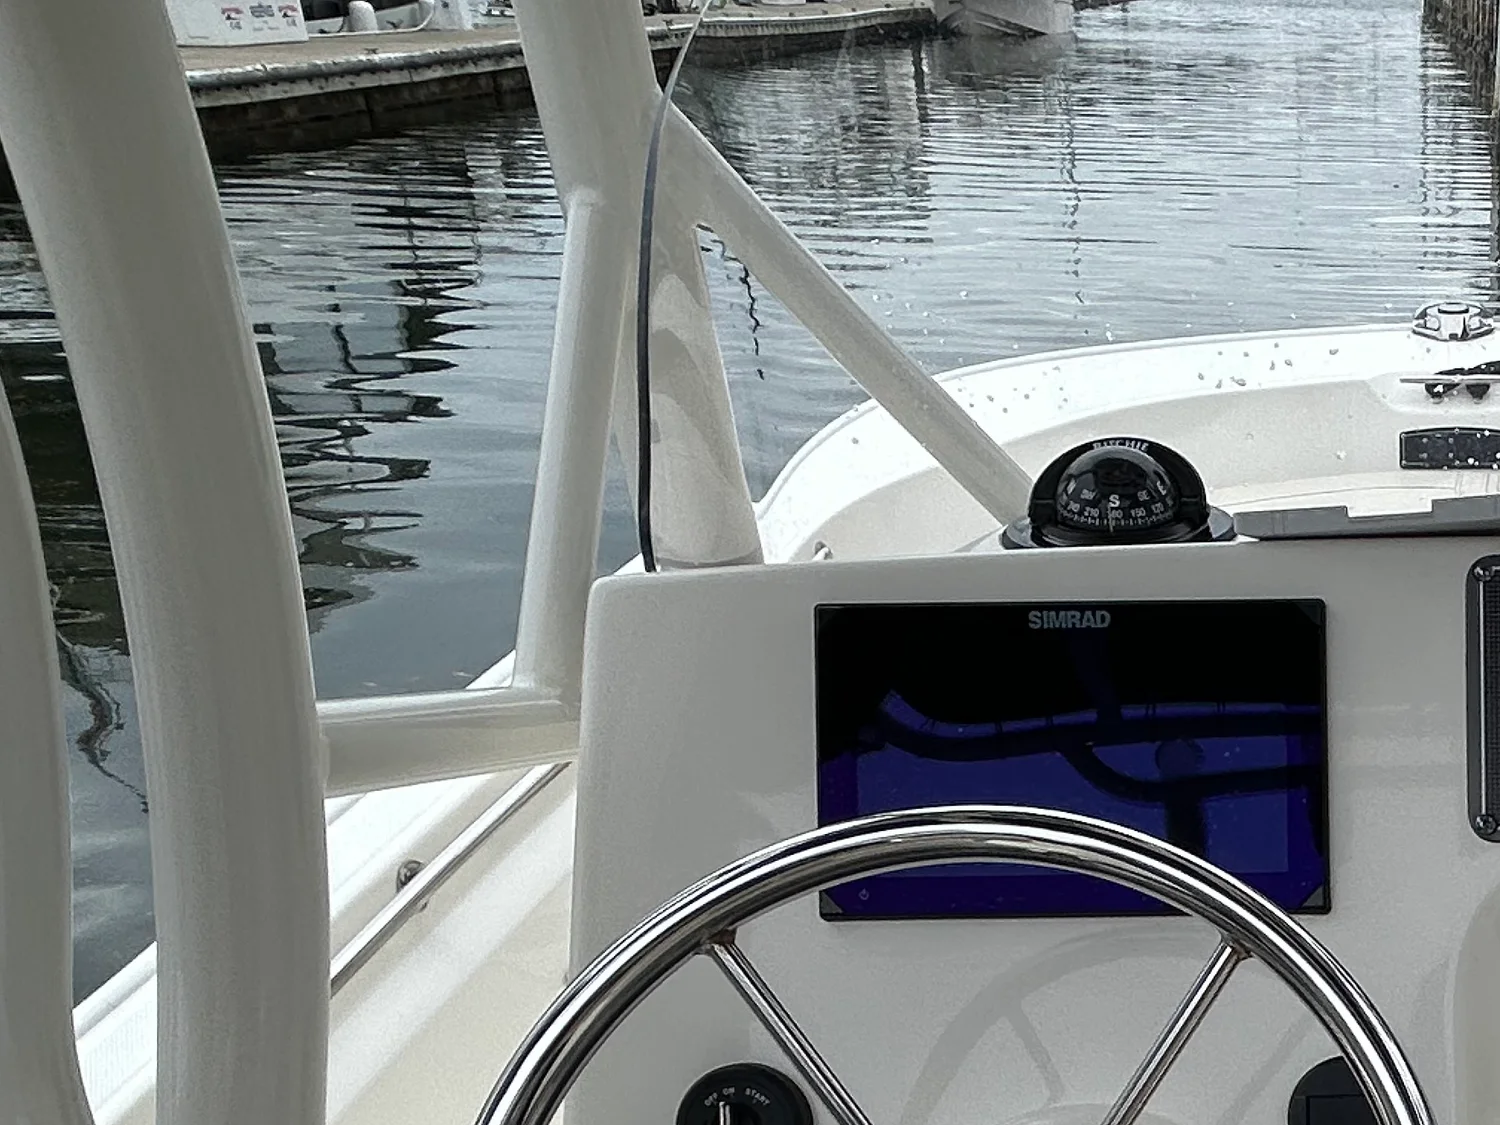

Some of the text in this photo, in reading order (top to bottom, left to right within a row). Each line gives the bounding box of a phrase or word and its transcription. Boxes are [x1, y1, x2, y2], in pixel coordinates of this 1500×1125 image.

[1108, 494, 1120, 507] S
[1028, 610, 1111, 629] SIMRAD
[744, 1087, 771, 1106] START
